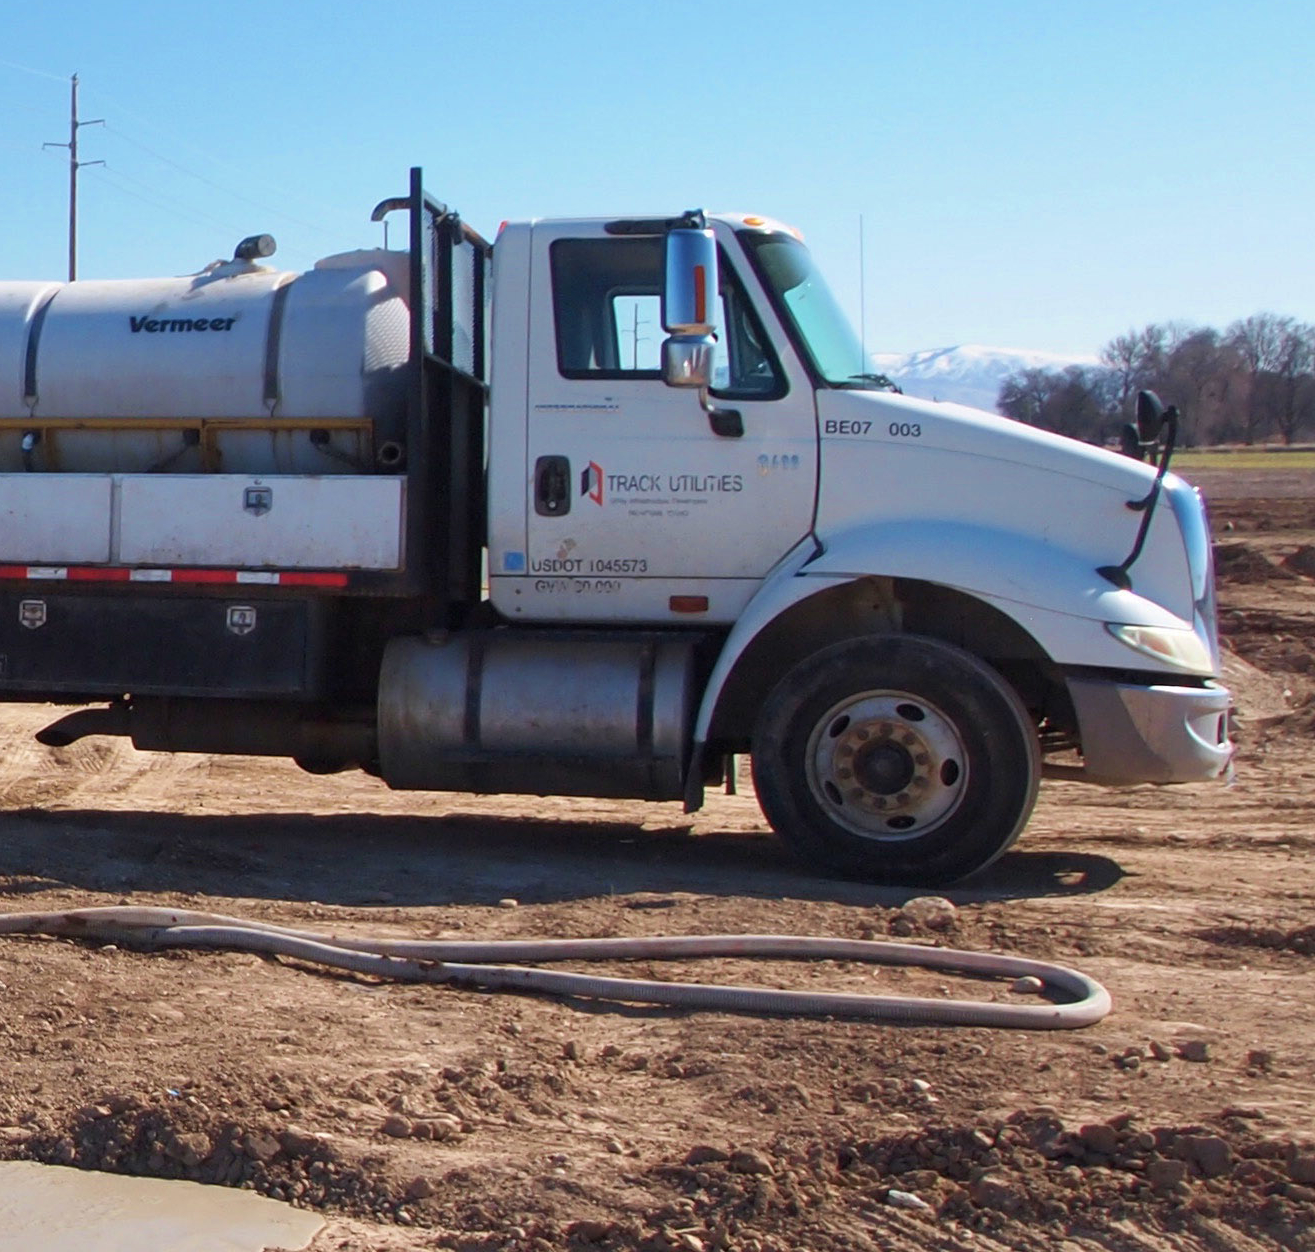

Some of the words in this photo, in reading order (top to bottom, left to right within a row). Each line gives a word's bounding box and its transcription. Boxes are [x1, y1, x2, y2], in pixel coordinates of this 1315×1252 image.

[129, 315, 237, 333] Vermeer
[825, 419, 872, 435] BE07
[888, 422, 922, 438] 003
[607, 475, 662, 492] TRACK
[668, 475, 744, 492] UTILITIES
[531, 559, 583, 573] USDOT
[589, 559, 648, 573] 1045573
